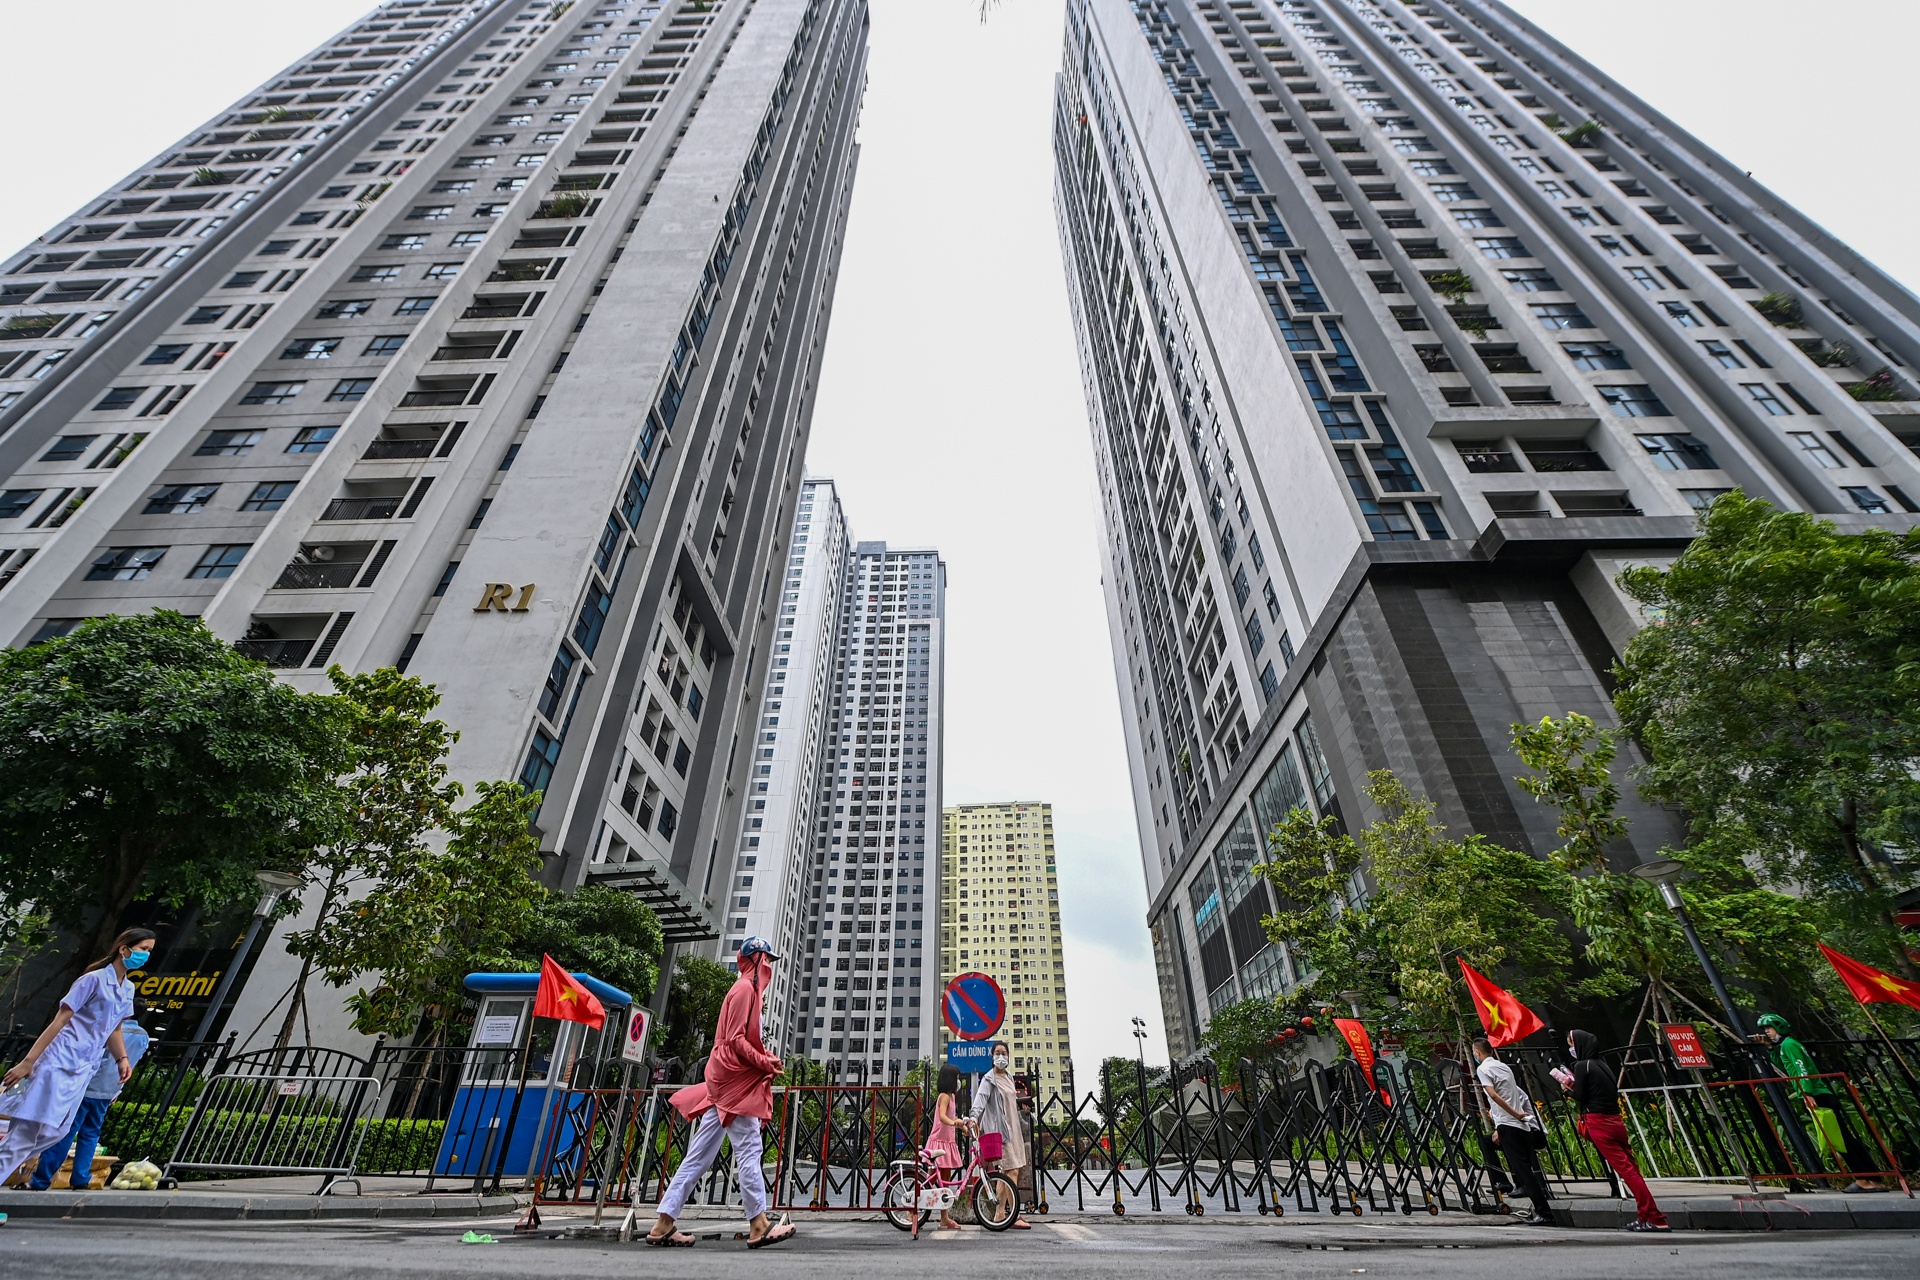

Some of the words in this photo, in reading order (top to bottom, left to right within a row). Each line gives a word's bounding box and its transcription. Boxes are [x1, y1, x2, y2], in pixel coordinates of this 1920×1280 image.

[473, 583, 536, 612] R1
[127, 970, 220, 996] Gemini
[166, 999, 184, 1009] Tea
[1680, 1032, 1695, 1041] VỰC
[952, 1044, 967, 1058] CẤM
